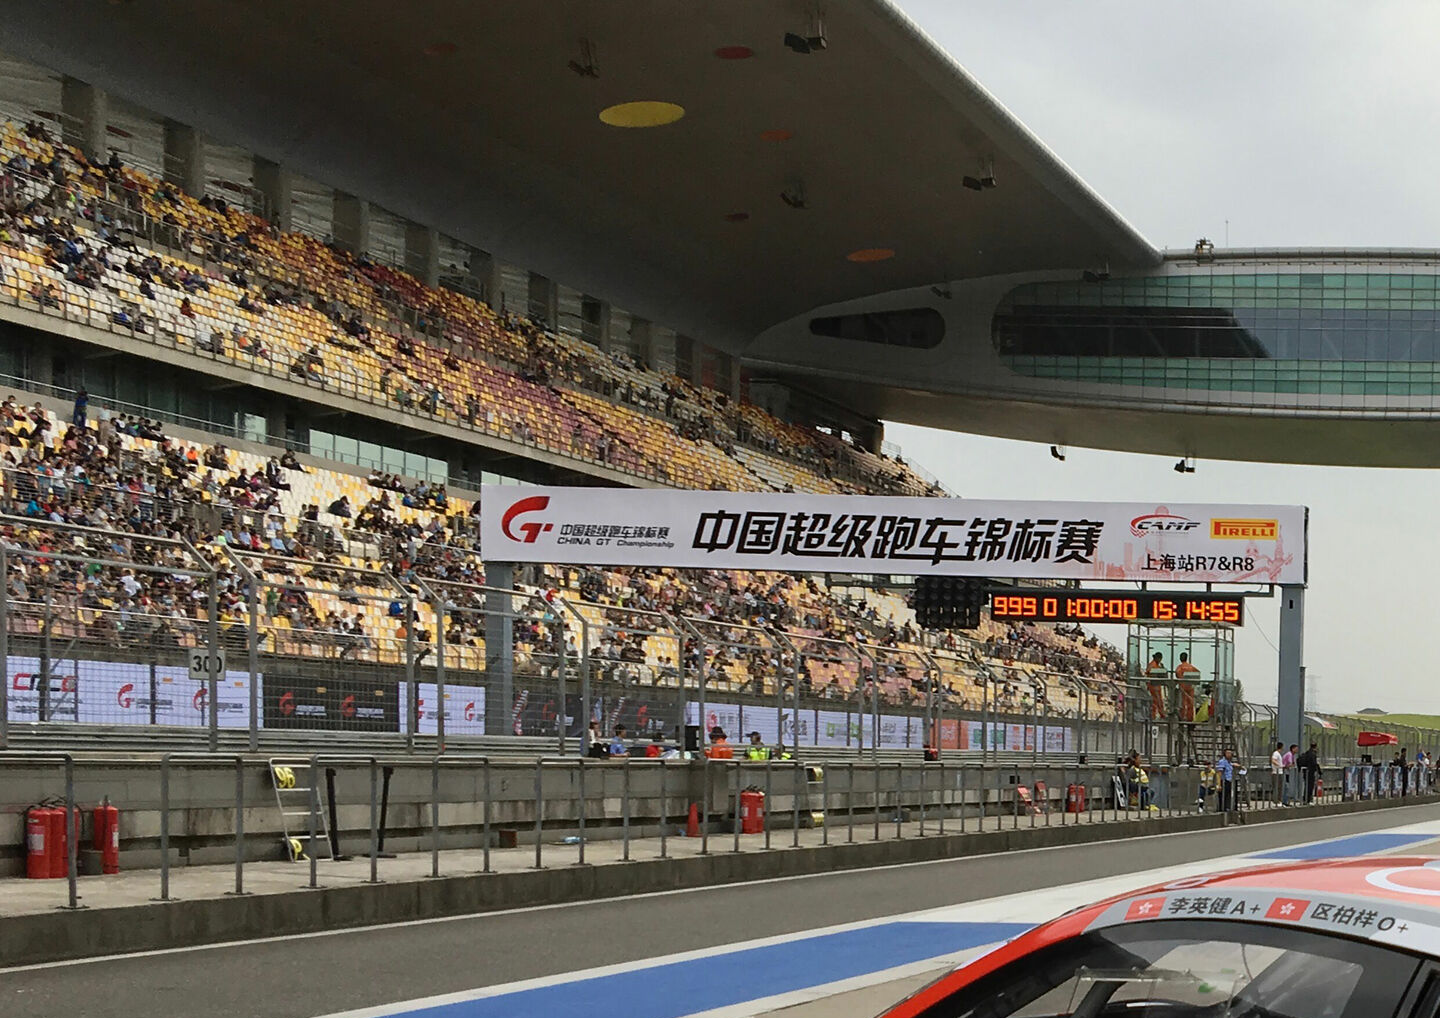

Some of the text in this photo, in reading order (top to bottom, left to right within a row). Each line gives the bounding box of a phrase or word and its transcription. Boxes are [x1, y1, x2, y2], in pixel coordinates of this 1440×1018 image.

[560, 523, 670, 540] 中国超级跑车锦标赛
[692, 509, 1105, 566] 中国超级跑车锦标赛
[1214, 521, 1276, 537] PIRELLI
[557, 537, 675, 549] CHINA GT Championship
[994, 596, 1037, 616] 999
[1067, 598, 1137, 618] 1:00:00
